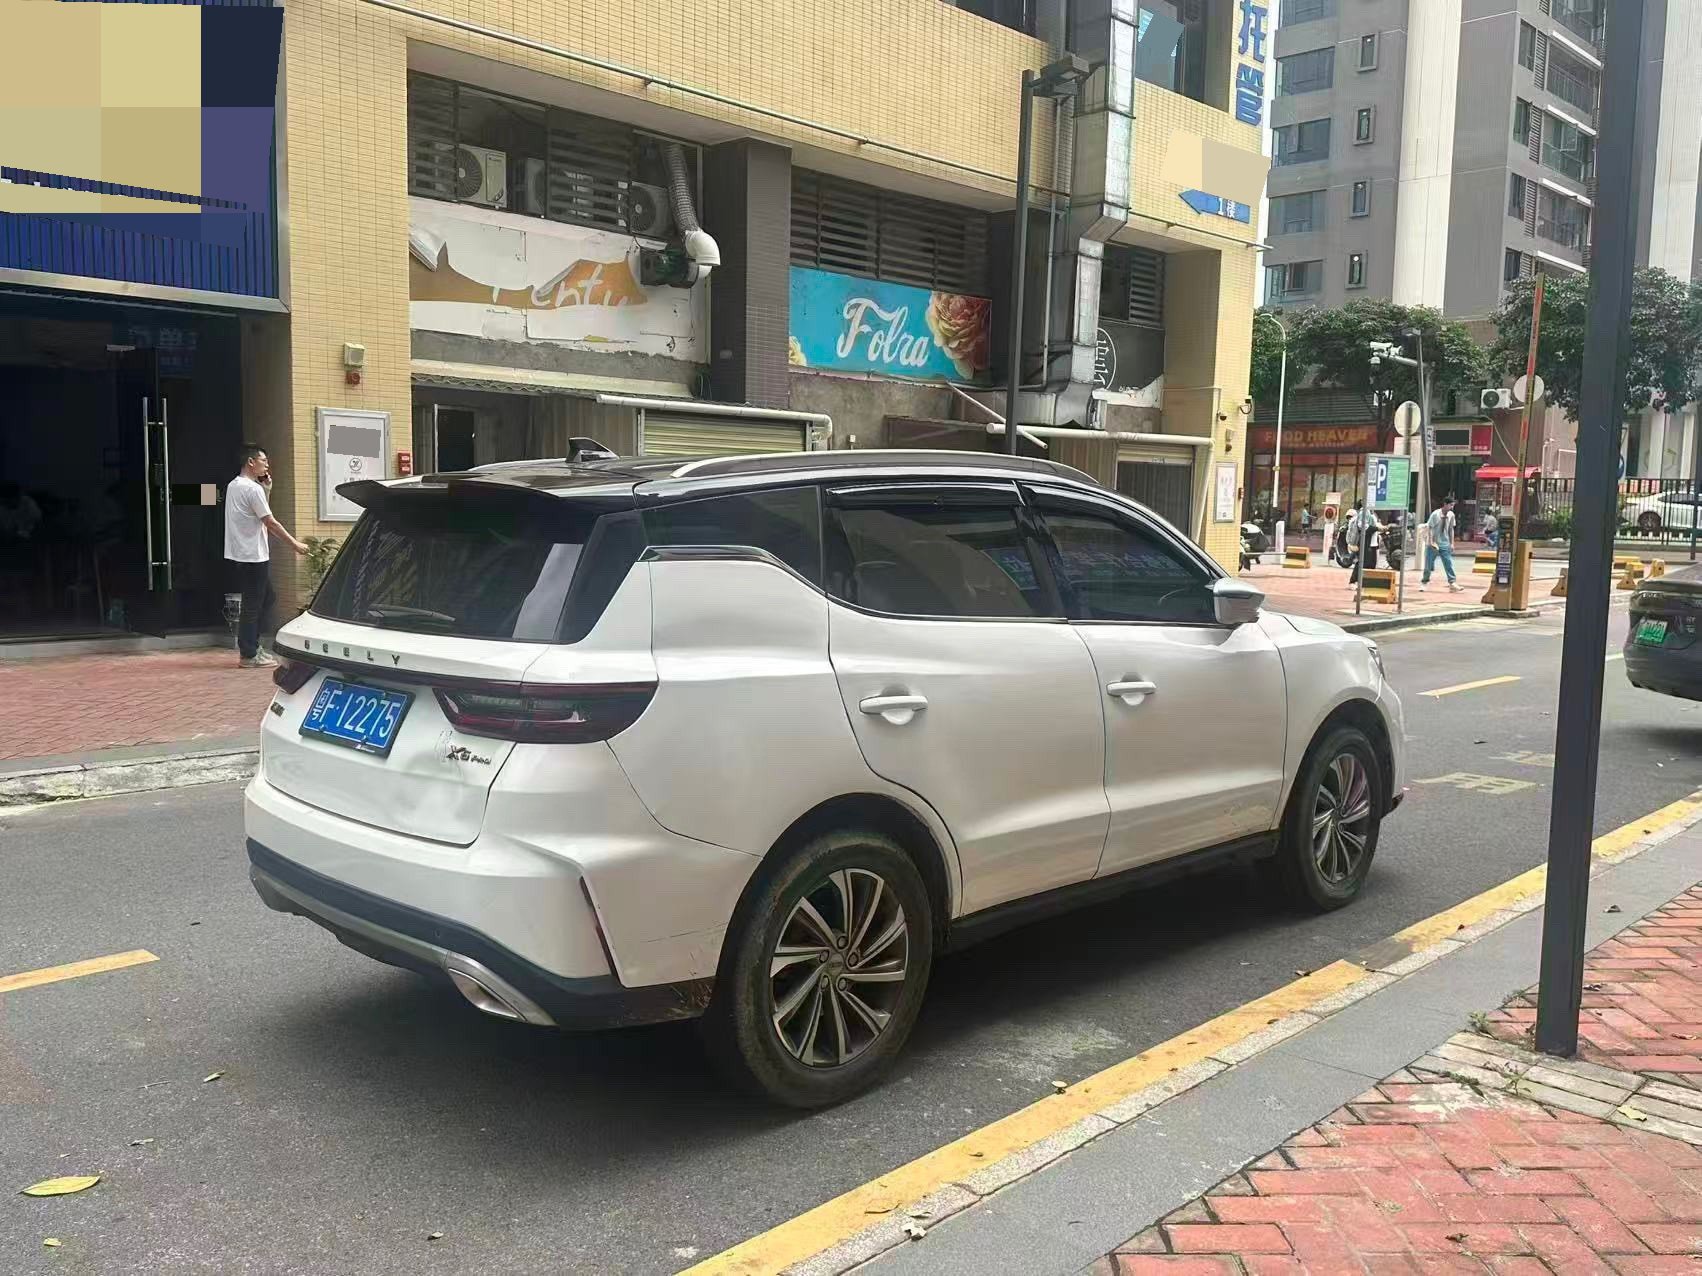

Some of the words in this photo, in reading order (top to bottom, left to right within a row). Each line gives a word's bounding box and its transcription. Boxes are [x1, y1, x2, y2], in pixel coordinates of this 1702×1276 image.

[1235, 0, 1268, 126] 托管
[1264, 430, 1304, 442] FOD
[1377, 463, 1387, 489] P
[304, 639, 400, 665] GEELY
